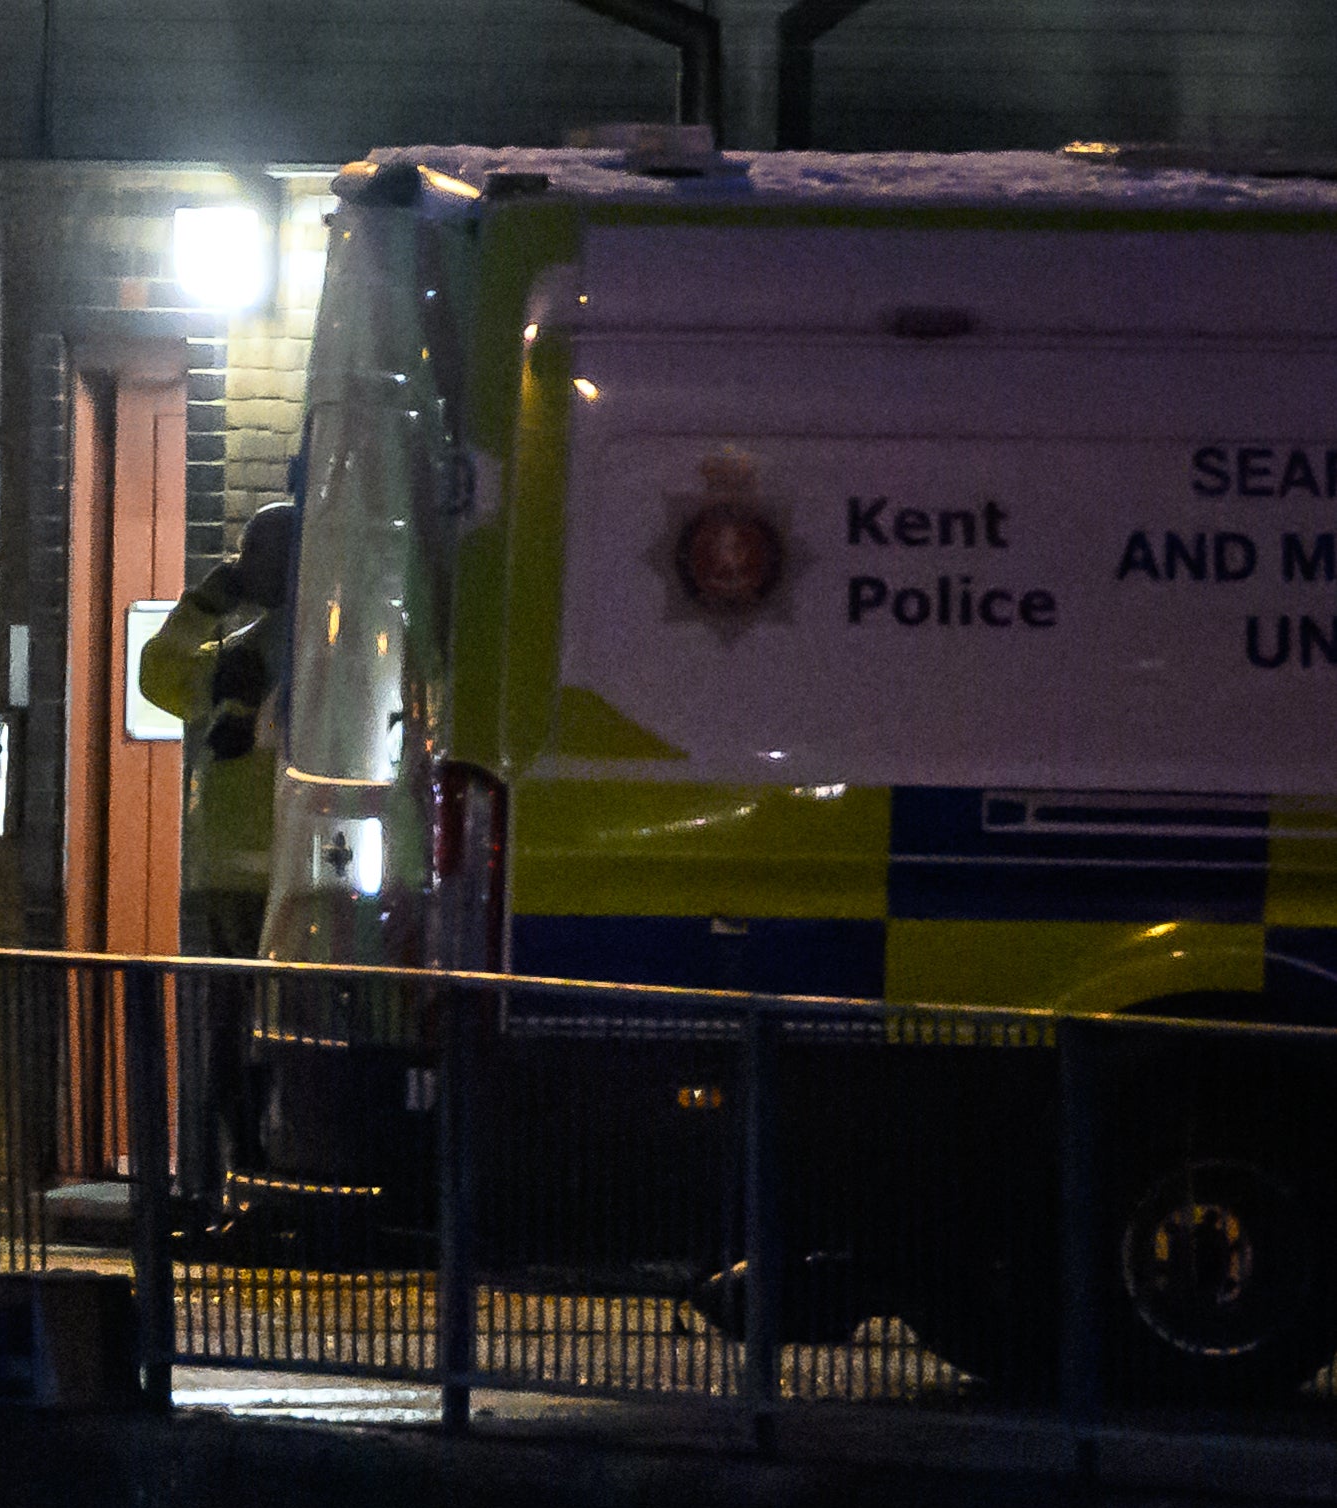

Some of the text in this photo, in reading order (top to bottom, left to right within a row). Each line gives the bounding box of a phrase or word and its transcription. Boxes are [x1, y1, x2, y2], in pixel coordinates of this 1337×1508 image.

[847, 497, 1009, 549] Kent
[1117, 531, 1256, 582] AND
[847, 577, 1058, 628] Police
